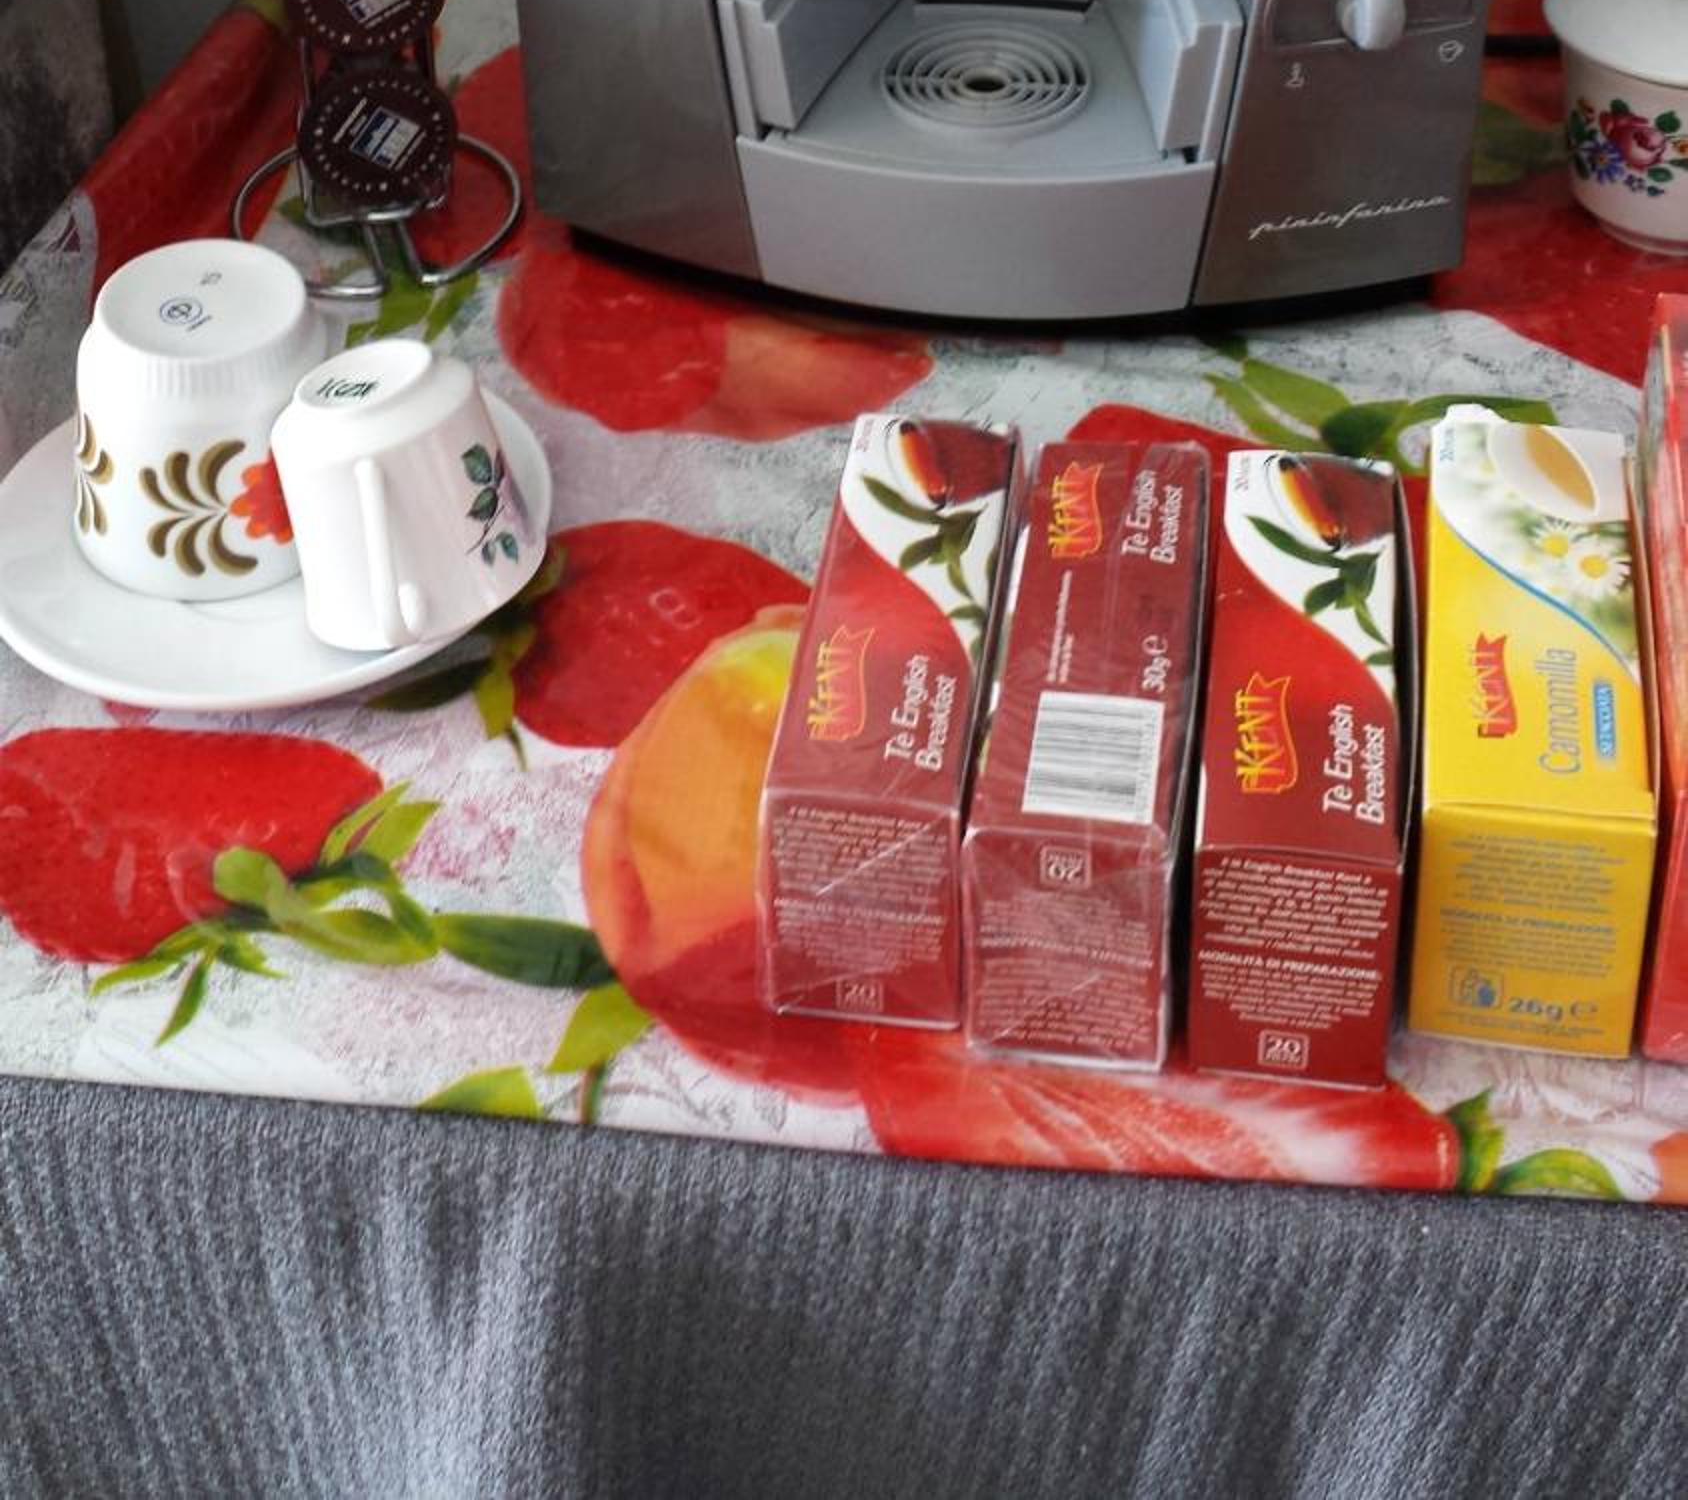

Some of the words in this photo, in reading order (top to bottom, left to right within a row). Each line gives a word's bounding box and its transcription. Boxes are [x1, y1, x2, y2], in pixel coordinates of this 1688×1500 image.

[1048, 474, 1092, 548] KENT
[1126, 469, 1158, 530] English
[1148, 484, 1183, 565] Breakfast
[806, 641, 852, 725] KENT
[889, 654, 930, 730] English
[914, 674, 957, 773] Breakfast
[1534, 648, 1582, 773] Camomilla
[1234, 688, 1285, 777] KENT
[1323, 703, 1358, 780] English
[1355, 724, 1386, 825] Breakfast
